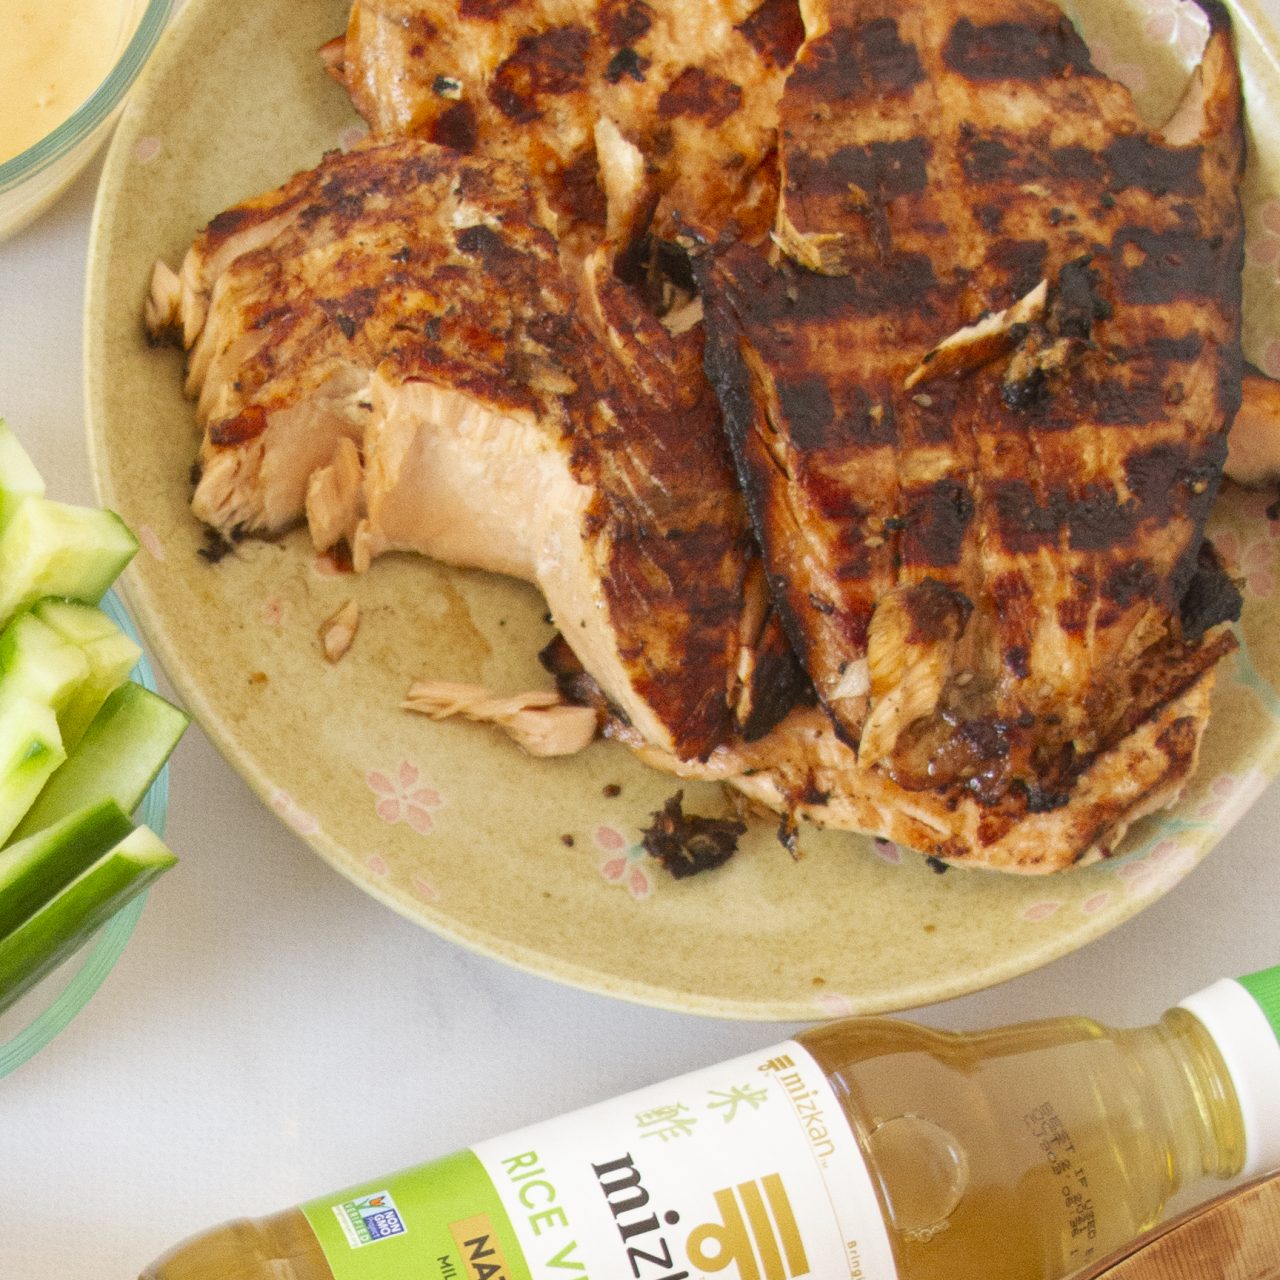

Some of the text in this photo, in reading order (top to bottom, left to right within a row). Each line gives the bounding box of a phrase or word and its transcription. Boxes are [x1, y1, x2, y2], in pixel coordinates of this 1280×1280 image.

[781, 1072, 836, 1158] mizkan
[501, 1150, 569, 1237] RICE
[344, 1202, 369, 1242] VERIFIED
[374, 1213, 391, 1236] GMO
[384, 1210, 401, 1233] NON
